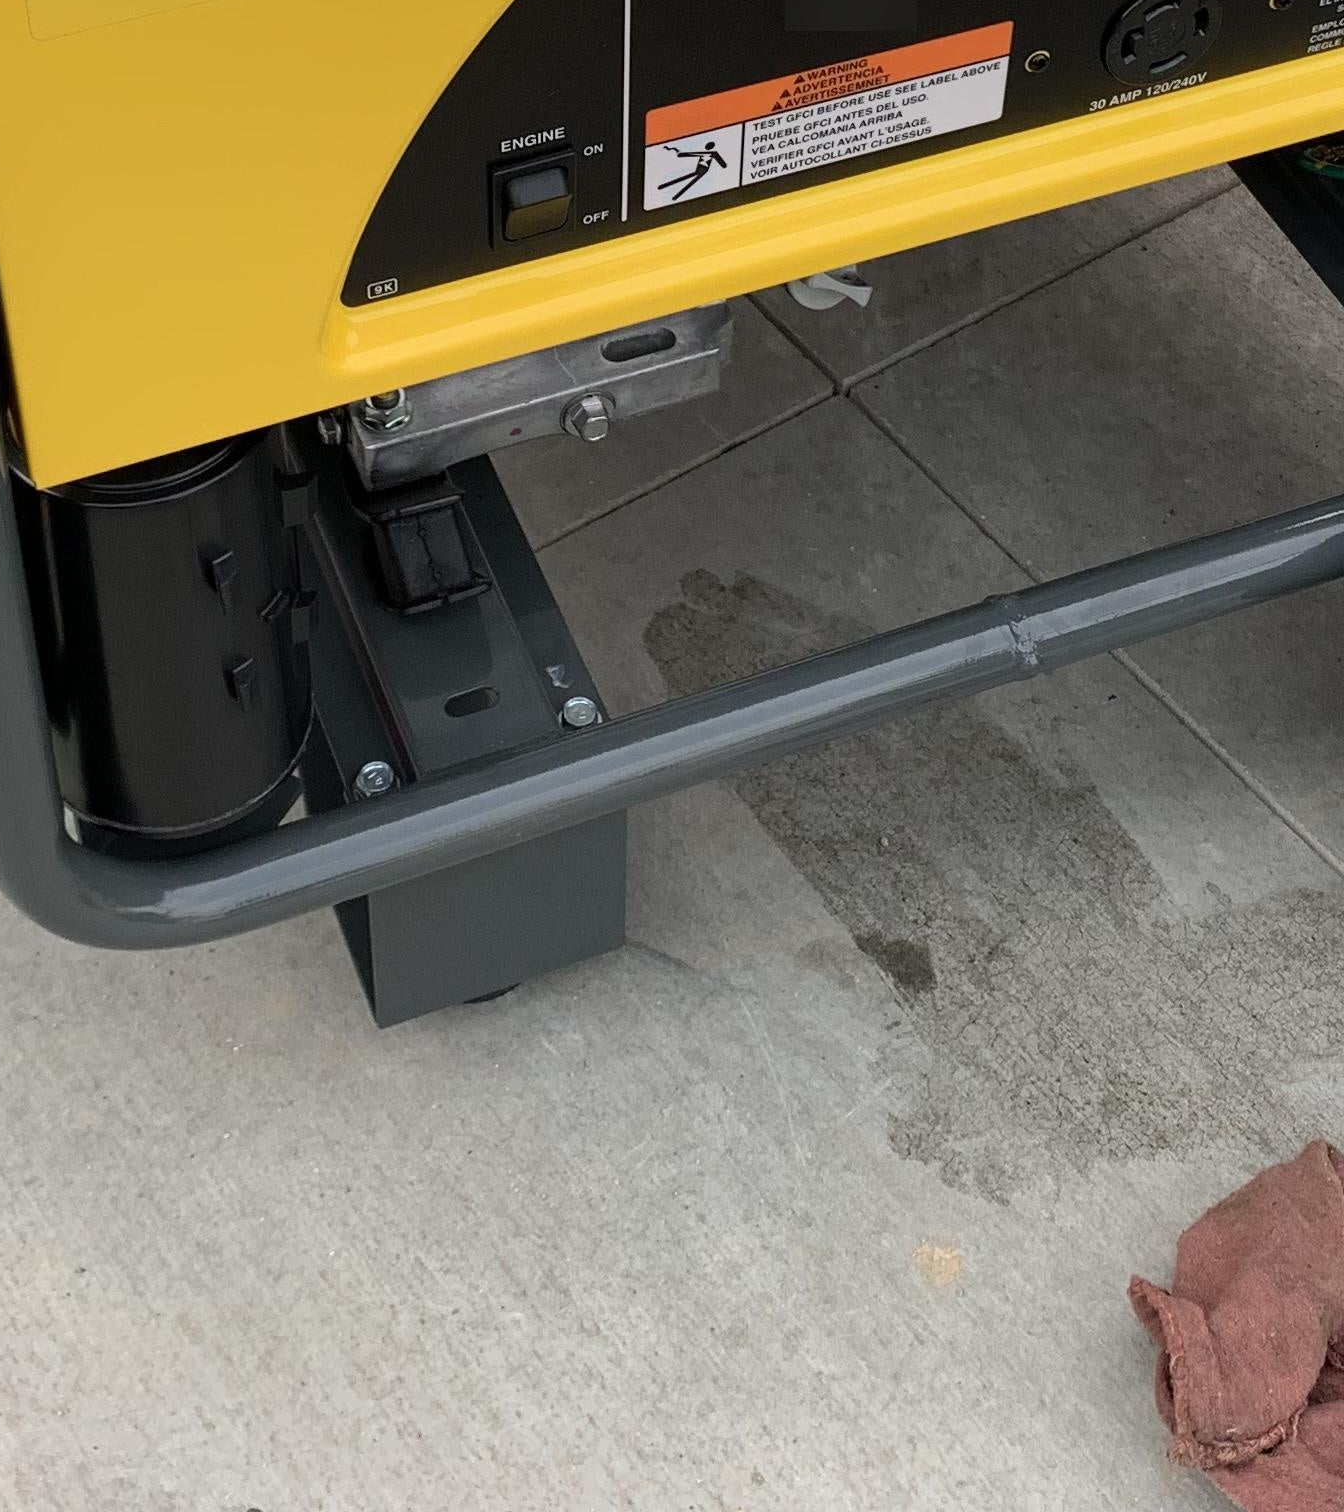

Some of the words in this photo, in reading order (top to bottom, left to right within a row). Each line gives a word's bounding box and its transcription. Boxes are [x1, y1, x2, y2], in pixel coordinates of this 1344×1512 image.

[792, 65, 884, 96] ADVERTENCIA
[806, 59, 868, 81] WARNING
[752, 116, 783, 131] TEST
[785, 108, 814, 123] GFCI
[816, 95, 865, 115] BEFORE
[867, 88, 891, 102] USE
[894, 82, 917, 96] SEE
[920, 73, 958, 89] LABEL
[960, 62, 1000, 79] ABOVE
[784, 75, 889, 111] AVERTISSEMNET
[1088, 98, 1107, 112] 30
[1108, 88, 1142, 106] AMP
[1146, 71, 1207, 96] 120/240V
[751, 125, 800, 145] PRUEBE
[803, 117, 832, 132] GFCI
[833, 106, 873, 124] ANTES
[875, 101, 899, 113] DEL
[901, 93, 927, 106] USO.
[751, 142, 775, 156] VEA
[777, 122, 856, 149] CALCOMANIA
[858, 110, 903, 129] ARRIBA
[500, 126, 565, 153] ENGINE
[583, 142, 604, 157] ON
[749, 165, 778, 180] VOIR
[780, 142, 867, 172] AUTOCOLLANT
[870, 126, 932, 149] CI-DESSUS
[750, 148, 804, 169] VERIFIER
[806, 140, 835, 155] GFCI
[836, 129, 875, 147] AVANT
[877, 116, 927, 136] L'USAGE.
[582, 209, 609, 225] OFF
